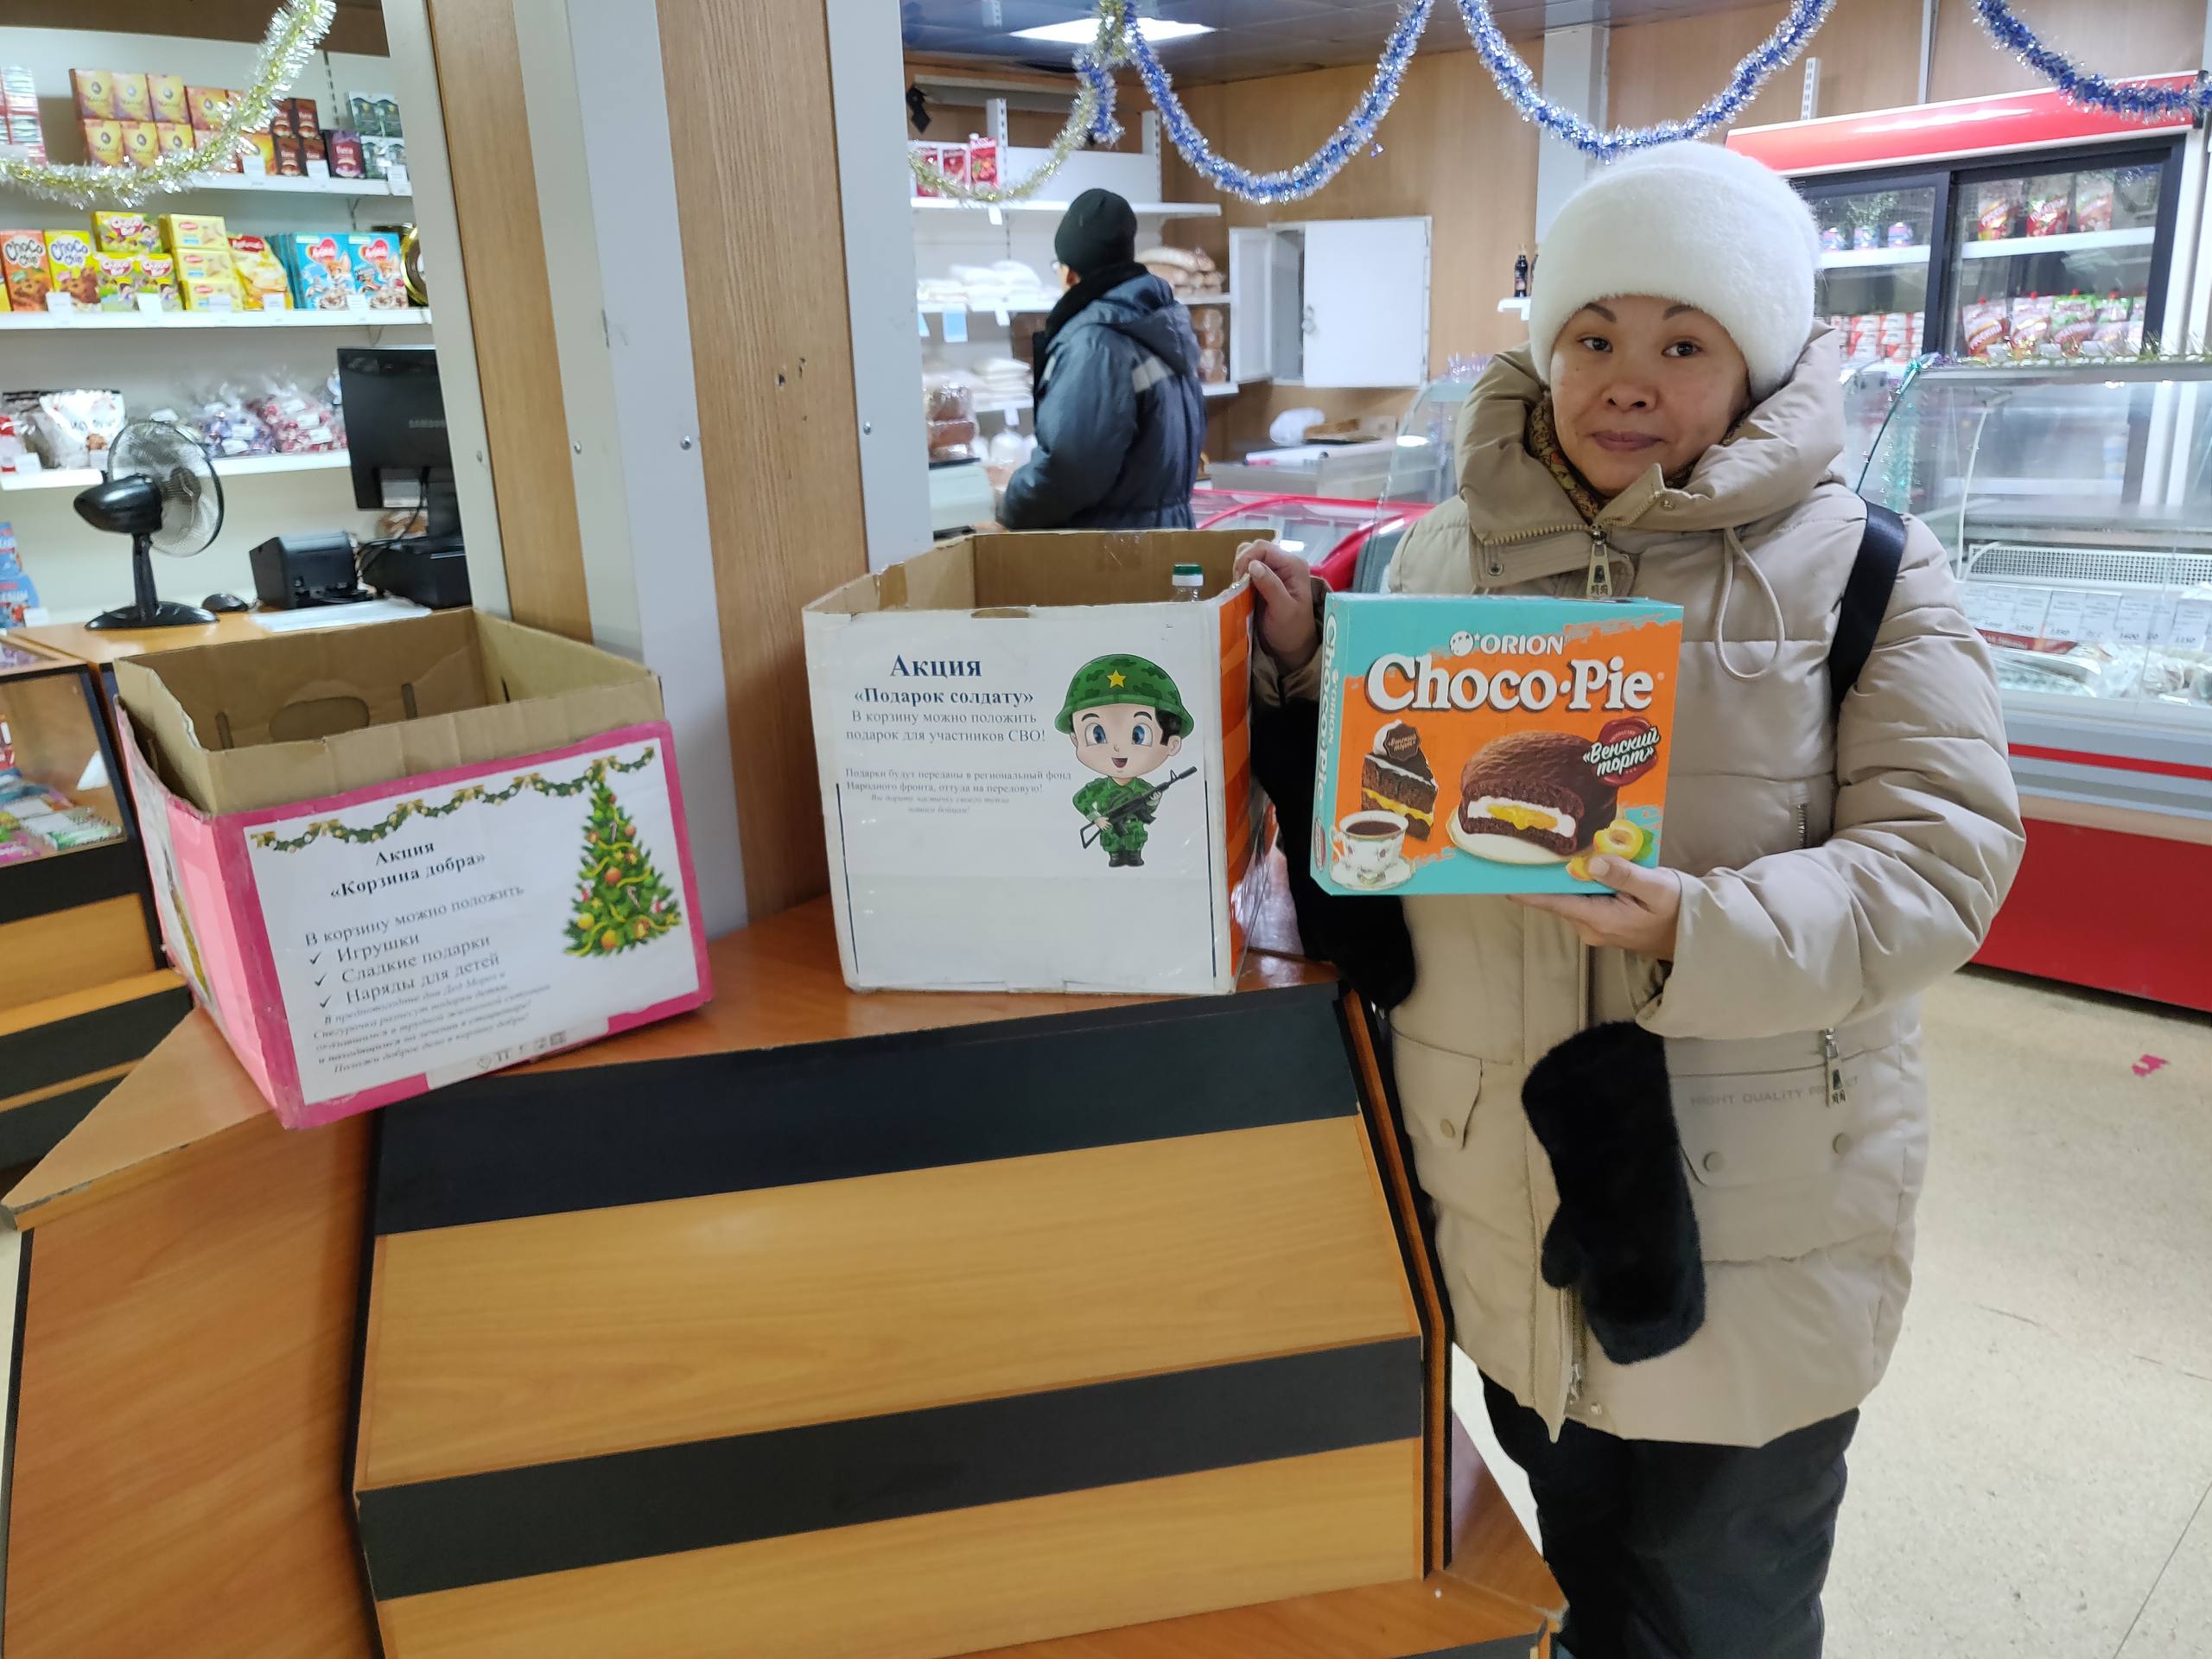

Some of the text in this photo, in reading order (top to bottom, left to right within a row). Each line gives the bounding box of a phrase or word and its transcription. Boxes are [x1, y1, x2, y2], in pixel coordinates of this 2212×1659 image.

[1479, 634, 1565, 656] ORION
[890, 654, 982, 678] Акция
[855, 688, 1034, 708] «Подарок солдату»
[852, 710, 1037, 725] В корзину можно положить
[846, 729, 1046, 745] подарок для участников СВО!
[1583, 727, 1659, 764] «Венский
[1597, 747, 1654, 777] торт»
[375, 842, 435, 866] Акция
[330, 854, 486, 899] «Корзина добра»
[305, 886, 524, 948] В корзину можно положить
[338, 934, 420, 963] Игрушки
[342, 936, 491, 983] Сладкие подарки
[346, 952, 500, 1005] Наряды для детей
[1742, 1089, 1803, 1104] QUALITY
